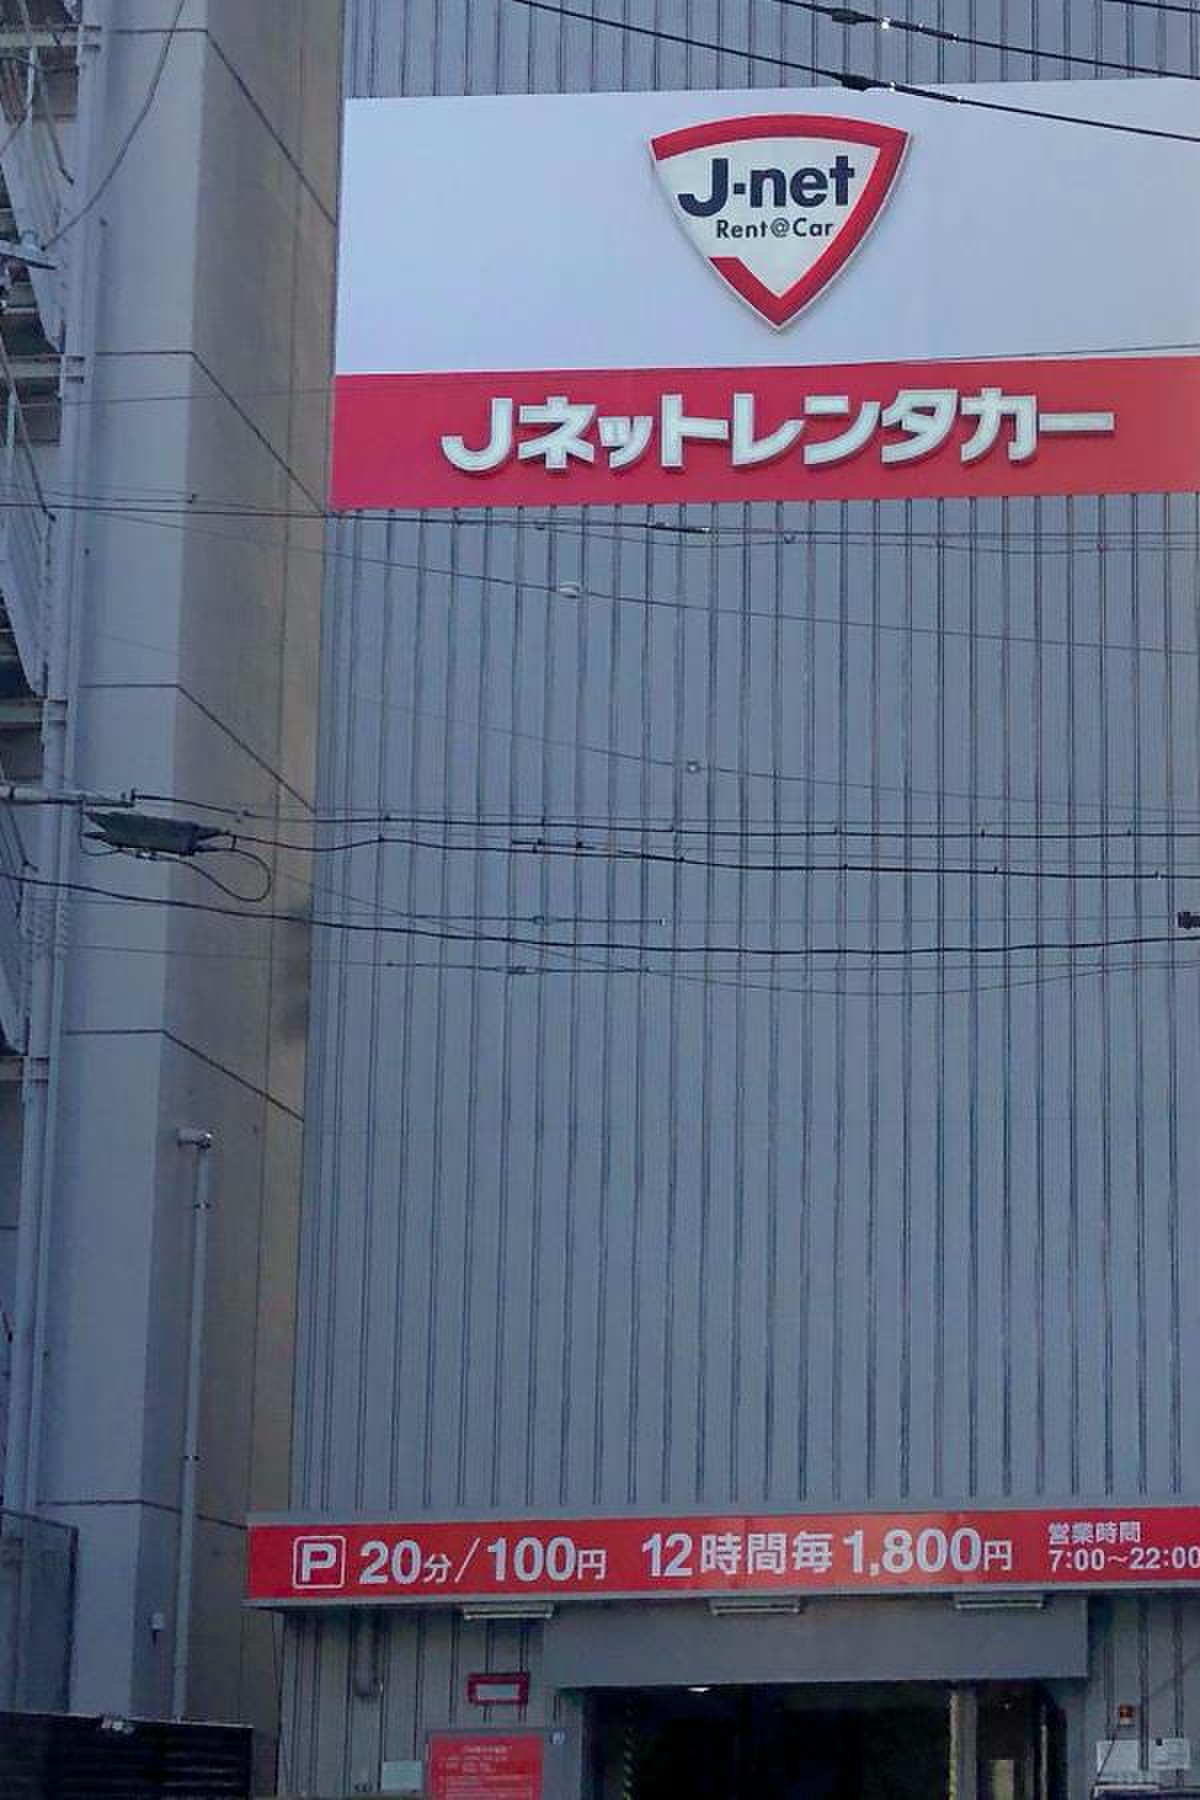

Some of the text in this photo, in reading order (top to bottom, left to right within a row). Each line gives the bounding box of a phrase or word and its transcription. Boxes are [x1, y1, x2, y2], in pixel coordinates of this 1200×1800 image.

[677, 155, 855, 218] J-net
[716, 217, 834, 239] Rent@Car
[441, 388, 1116, 472] Jネットレンタカー
[1048, 1521, 1141, 1545] 営業時間
[301, 1543, 337, 1582] P
